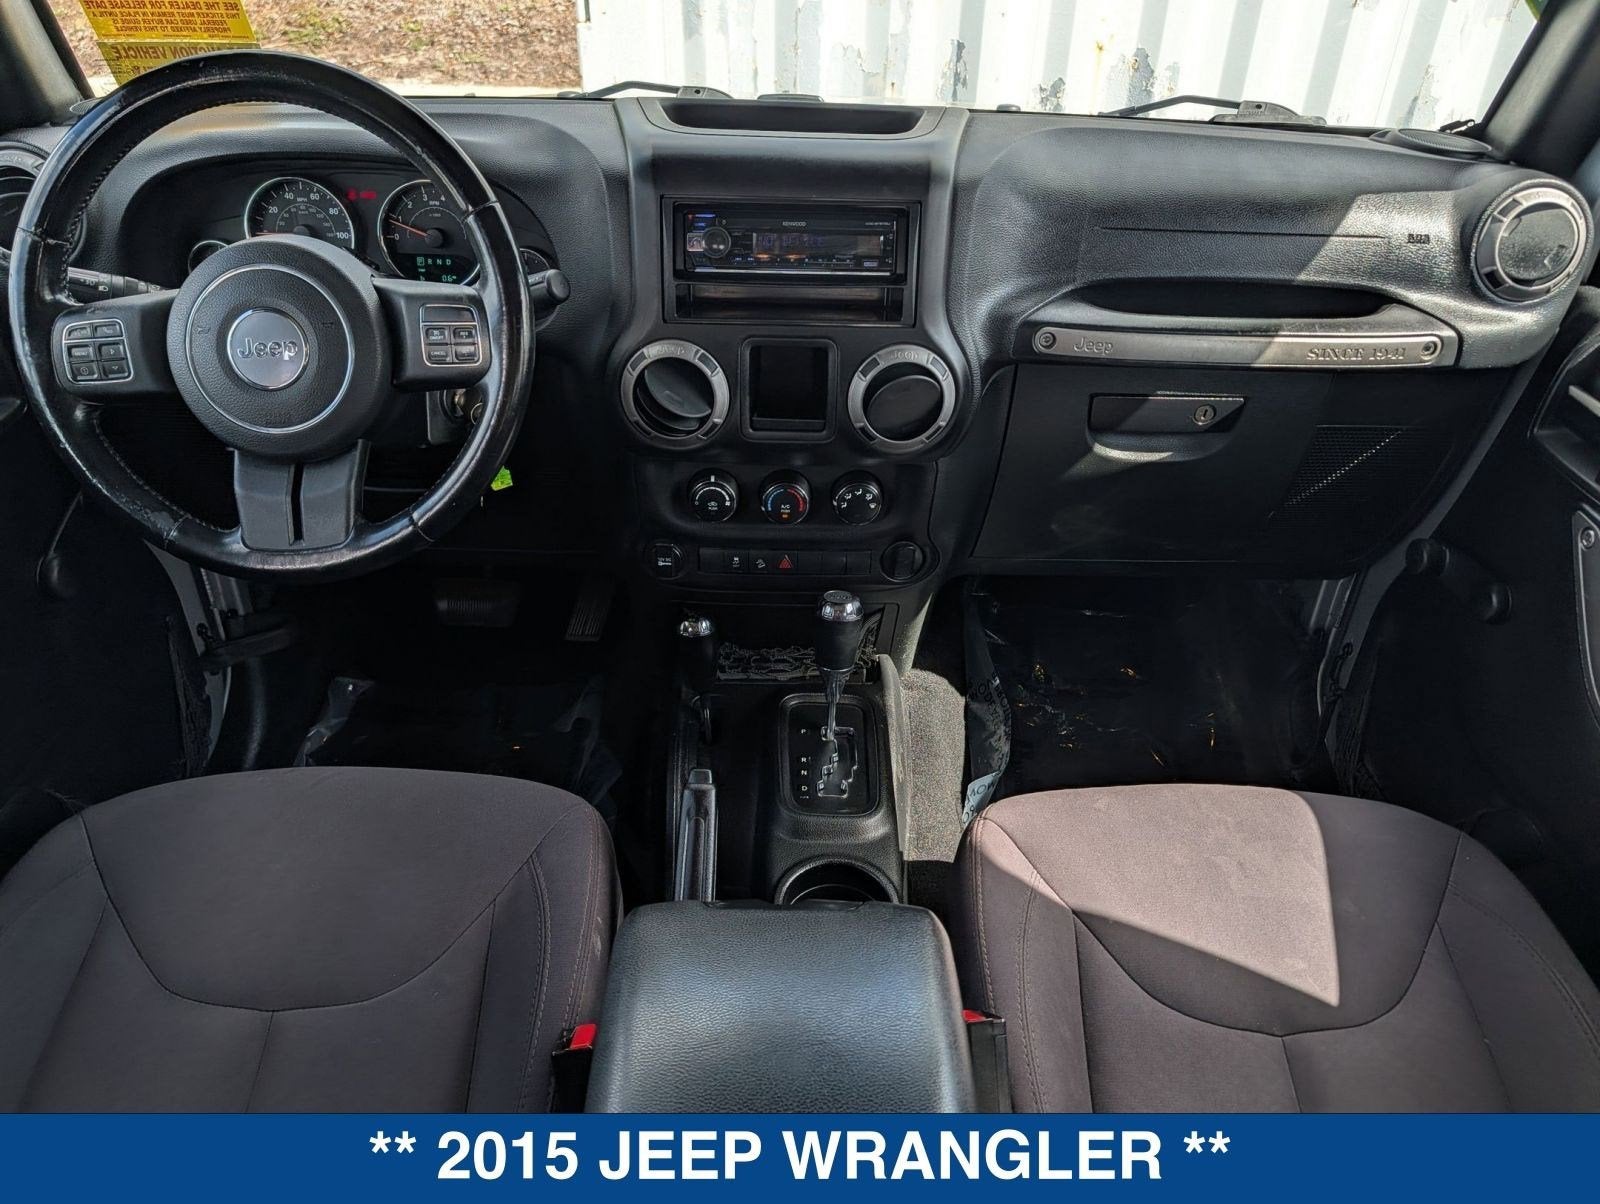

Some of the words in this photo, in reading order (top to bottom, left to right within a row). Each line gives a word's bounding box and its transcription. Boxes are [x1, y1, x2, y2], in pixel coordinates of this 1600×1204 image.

[284, 192, 294, 200] 40
[310, 193, 320, 201] 60
[268, 206, 278, 214] 20
[329, 207, 339, 215] 80
[237, 337, 298, 360] Jeep
[1073, 337, 1113, 356] Jeep
[1306, 348, 1364, 360] SINCE
[1369, 347, 1406, 360] 1941
